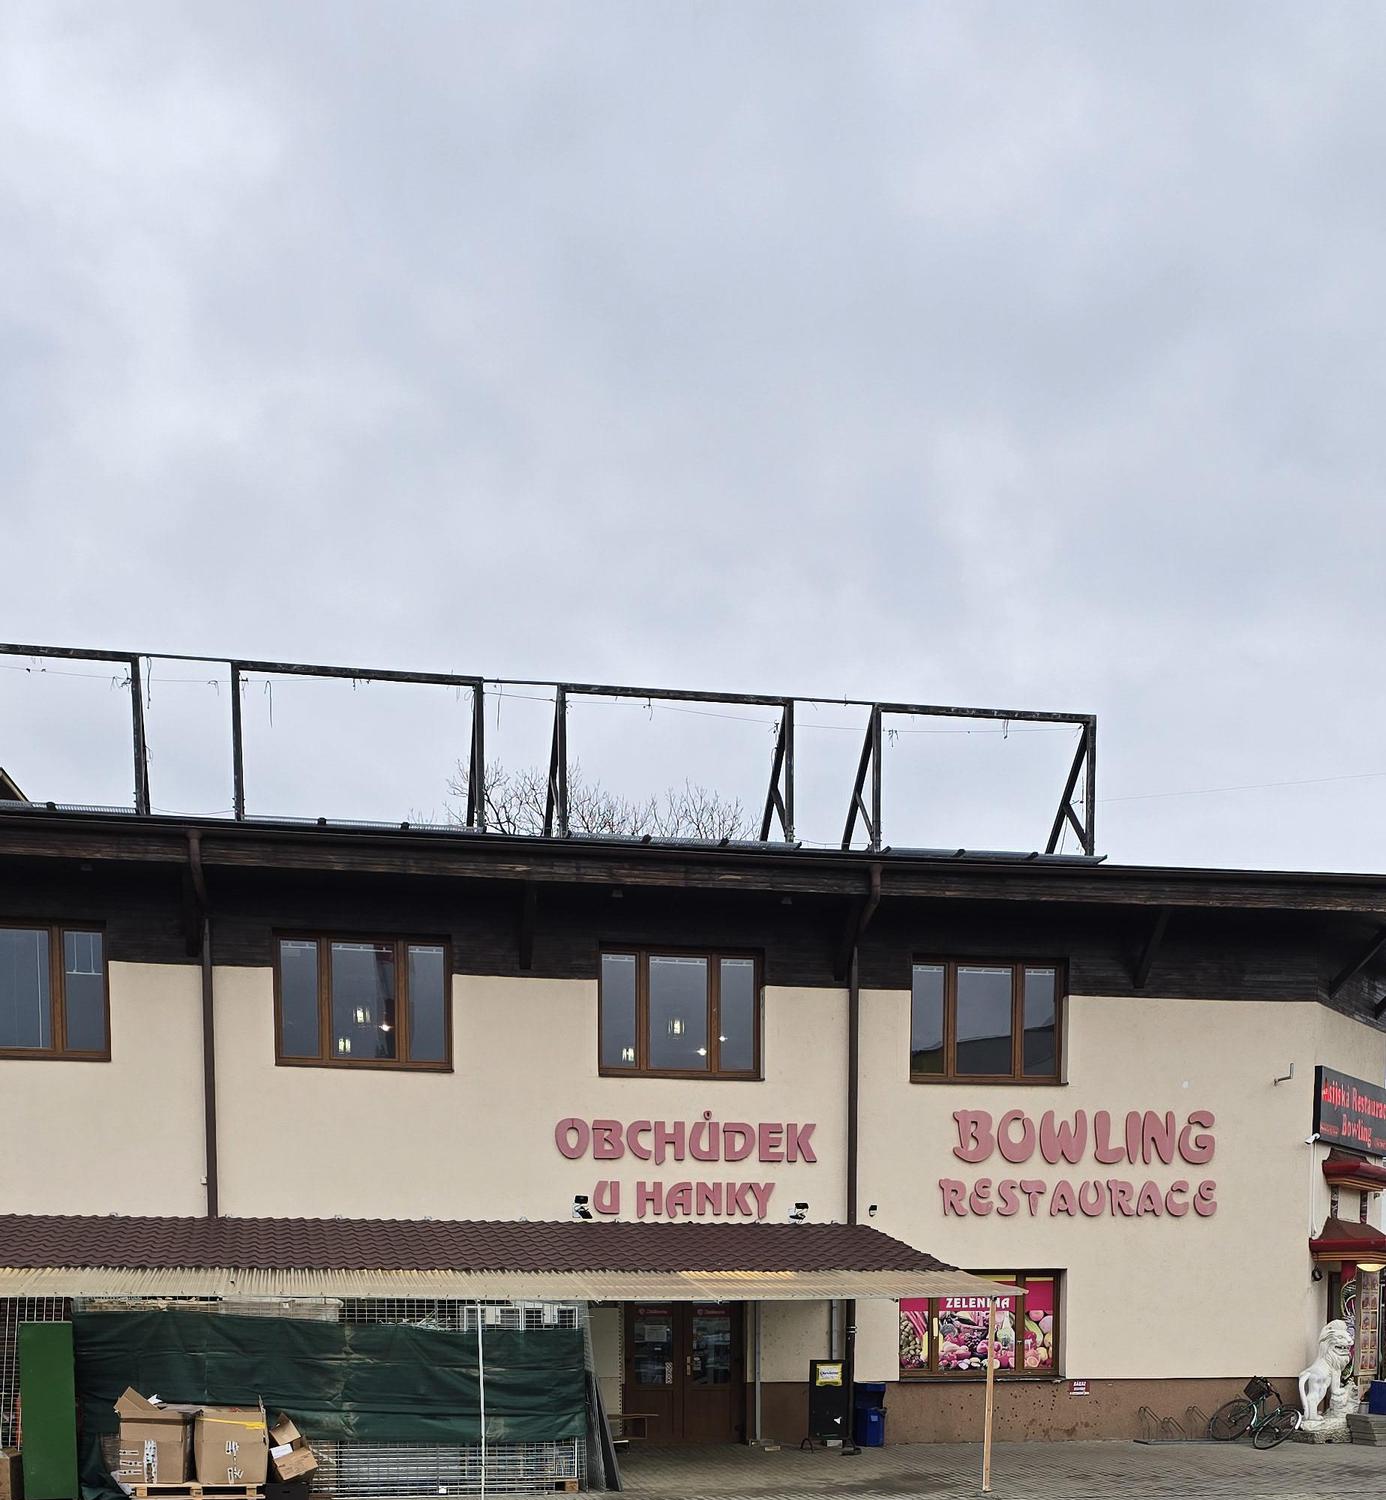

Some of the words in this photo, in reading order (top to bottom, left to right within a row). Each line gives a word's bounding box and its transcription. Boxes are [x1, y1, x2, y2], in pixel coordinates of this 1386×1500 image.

[555, 1110, 817, 1165] OBCHŮDEK
[953, 1109, 1215, 1164] BOWLING
[1341, 1113, 1372, 1148] Bowling
[593, 1180, 620, 1214] U
[636, 1181, 776, 1219] HANKY
[939, 1178, 1217, 1217] RESTAURACE
